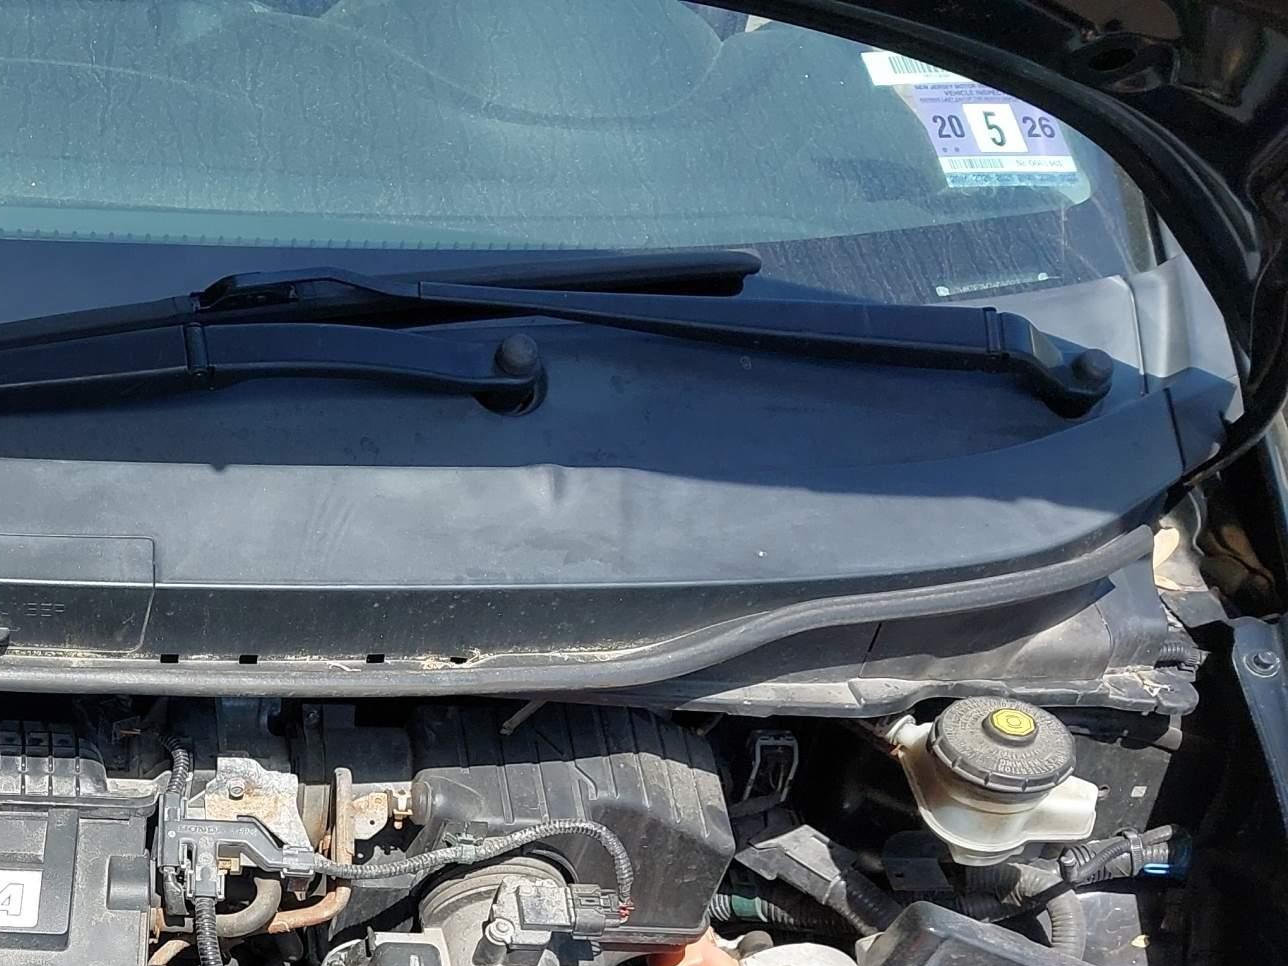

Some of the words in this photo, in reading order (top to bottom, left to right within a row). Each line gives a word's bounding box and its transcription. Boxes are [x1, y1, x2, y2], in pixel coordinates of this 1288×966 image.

[932, 114, 965, 138] 20
[983, 111, 1006, 147] 5
[1022, 116, 1055, 138] 26
